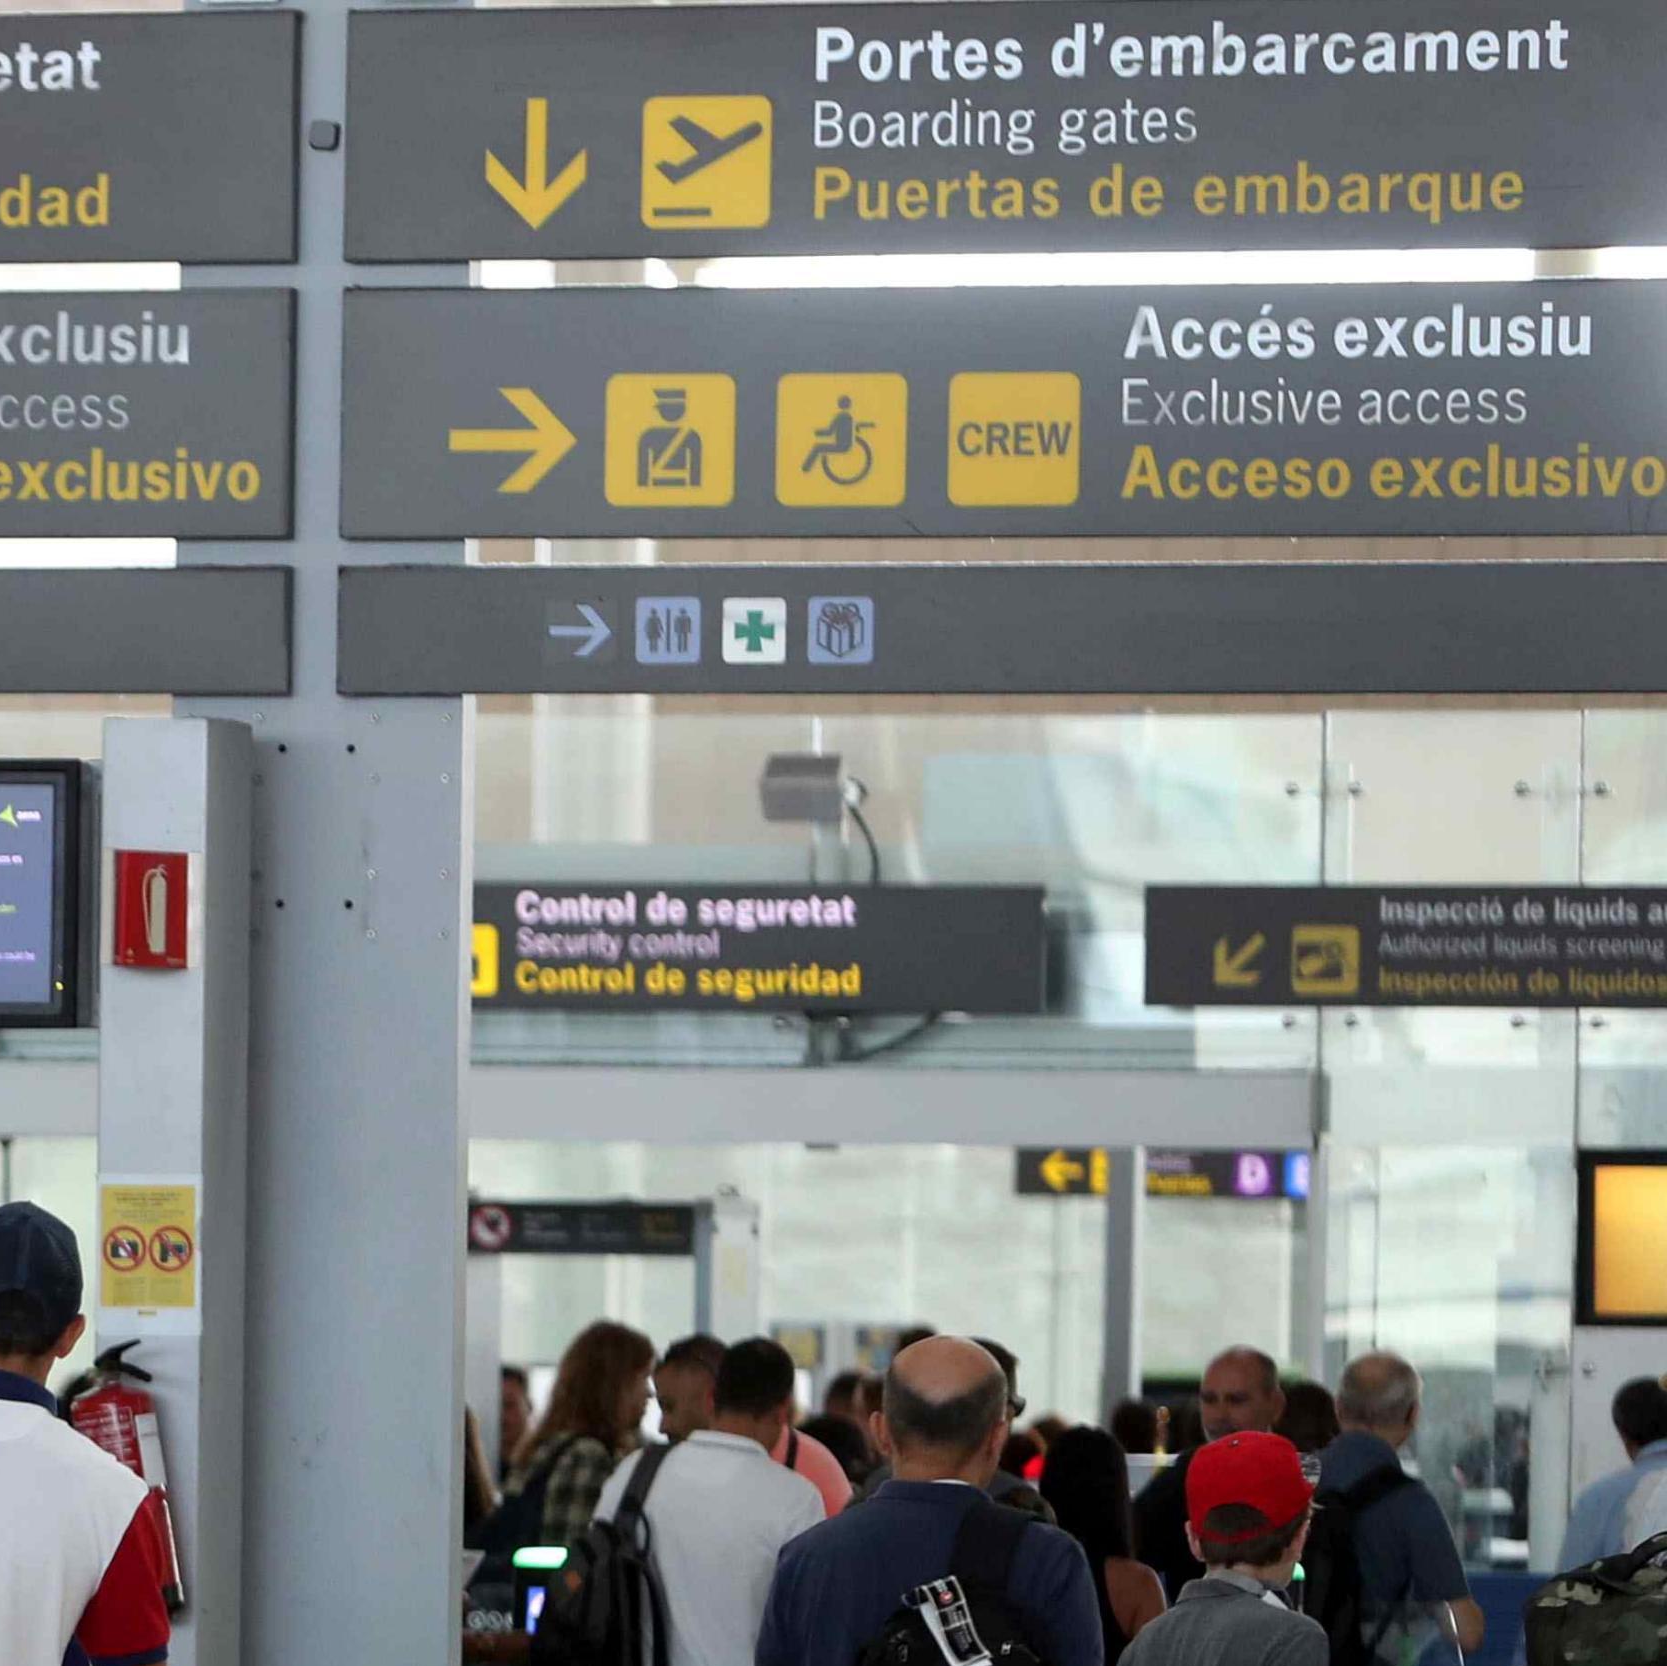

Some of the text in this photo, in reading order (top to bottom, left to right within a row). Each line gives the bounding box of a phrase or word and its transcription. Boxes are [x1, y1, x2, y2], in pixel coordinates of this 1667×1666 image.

[815, 18, 1569, 82] Portes d'embarcament
[814, 97, 1198, 155] Boarding gates
[813, 162, 1525, 223] Puertas de embarque
[1124, 301, 1593, 360] Accés exclusiu
[1121, 376, 1528, 426] Exclusive access
[956, 419, 1073, 458] CREW
[1122, 443, 1667, 501] Acceso exclusivo
[514, 890, 857, 930] Control de seguretat
[1379, 895, 1505, 929] Inspecció
[1512, 896, 1546, 925] de
[516, 926, 720, 962] Security control
[1378, 931, 1666, 964] Authorized liquids screening
[514, 958, 863, 1003] Control de seguridad
[1527, 967, 1564, 994] de
[1237, 1152, 1269, 1196] D
